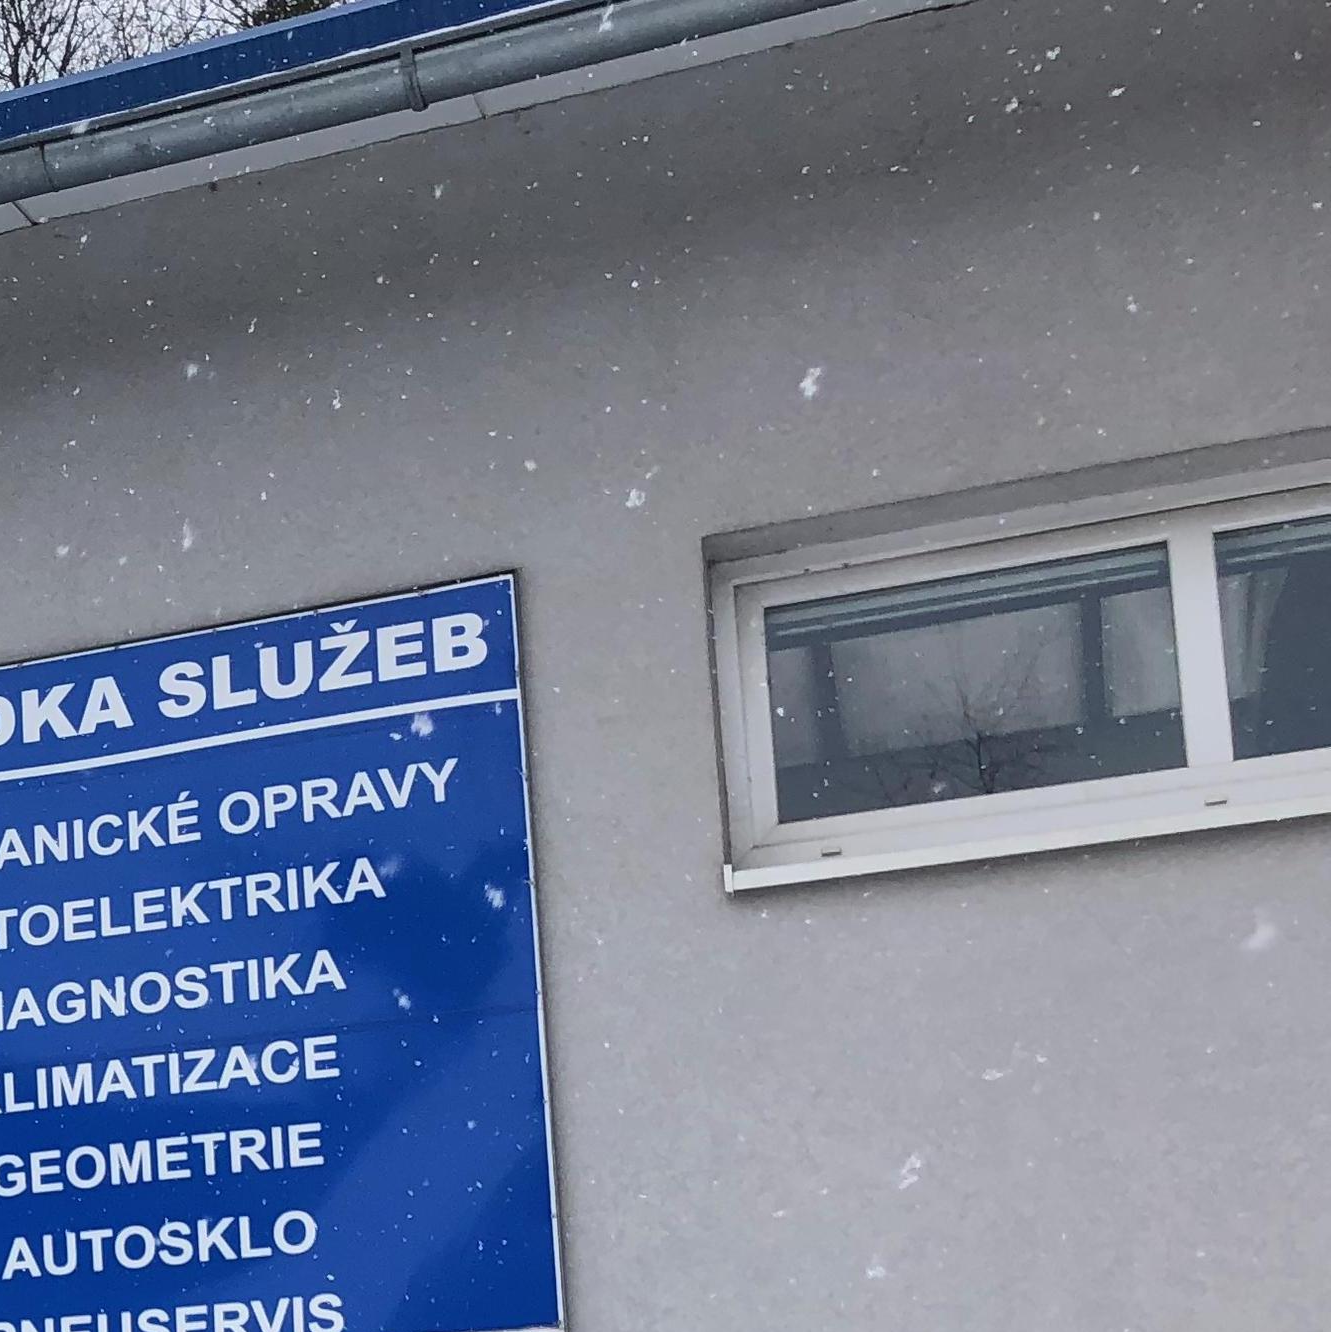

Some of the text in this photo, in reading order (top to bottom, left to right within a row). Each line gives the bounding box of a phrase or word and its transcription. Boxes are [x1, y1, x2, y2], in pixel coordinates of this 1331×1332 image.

[158, 612, 488, 719] SLUŽEB
[219, 758, 458, 835] OPRAVY
[2, 1210, 318, 1280] AUTOSKLO
